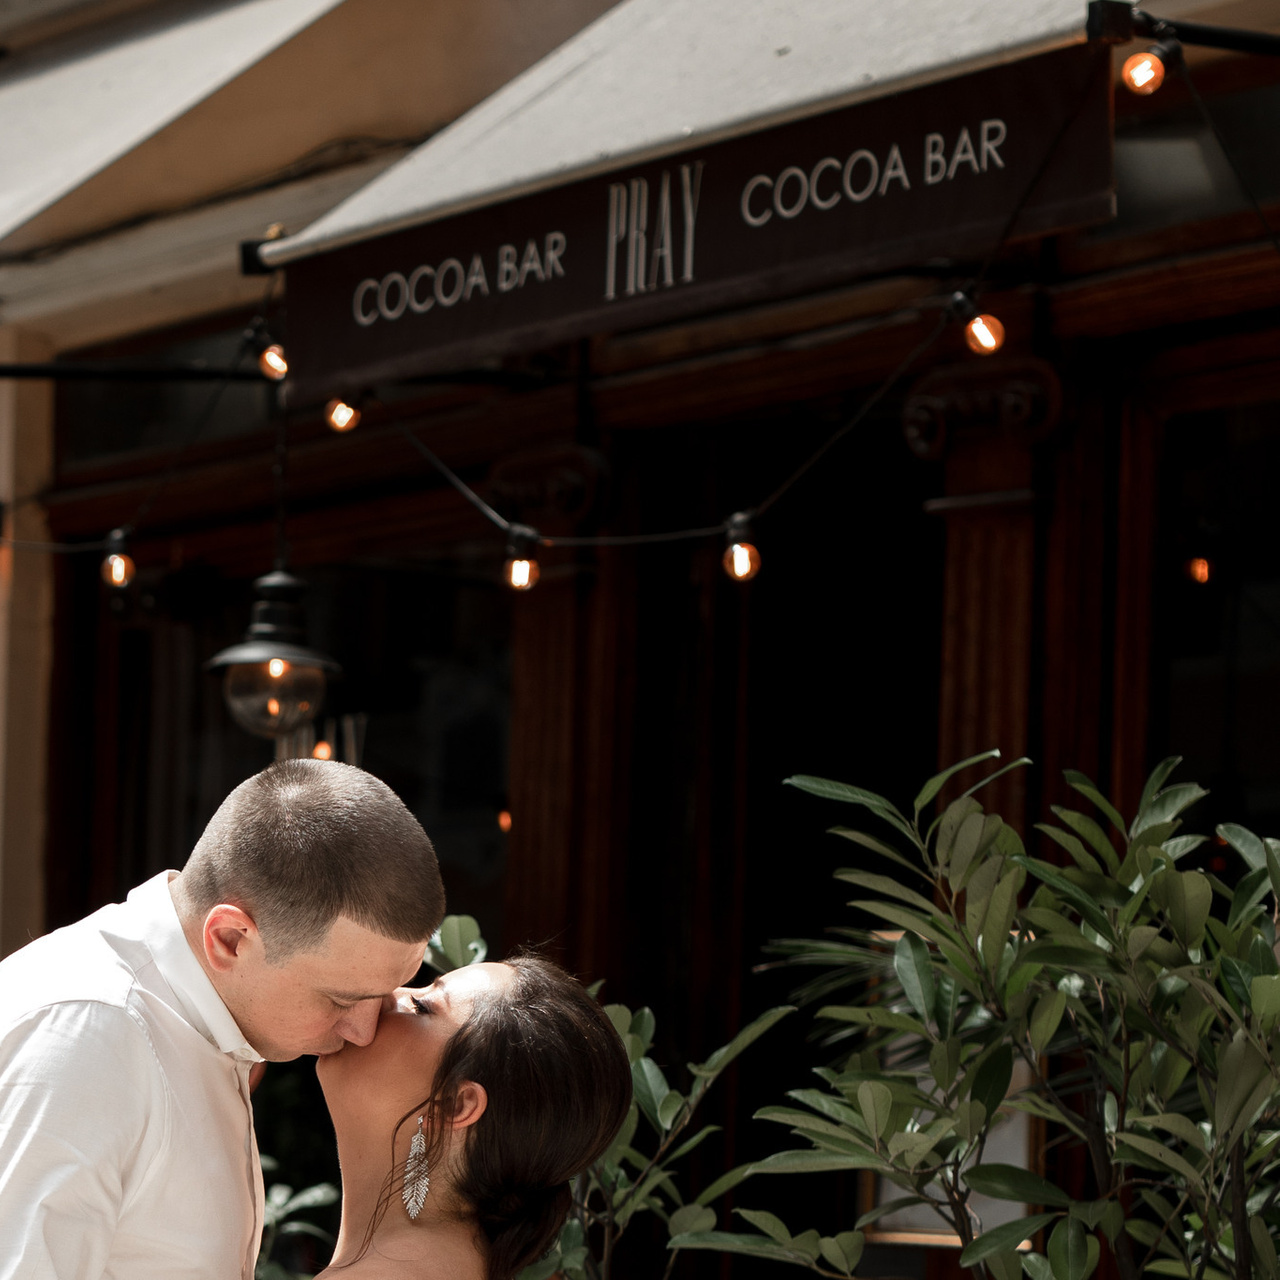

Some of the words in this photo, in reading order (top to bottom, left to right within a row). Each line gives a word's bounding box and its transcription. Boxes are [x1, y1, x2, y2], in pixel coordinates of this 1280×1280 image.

[352, 254, 489, 326] COCOA
[497, 231, 567, 292] BAR
[604, 160, 706, 299] PRAY
[741, 144, 910, 226] COCOA
[924, 118, 1007, 185] BAR
